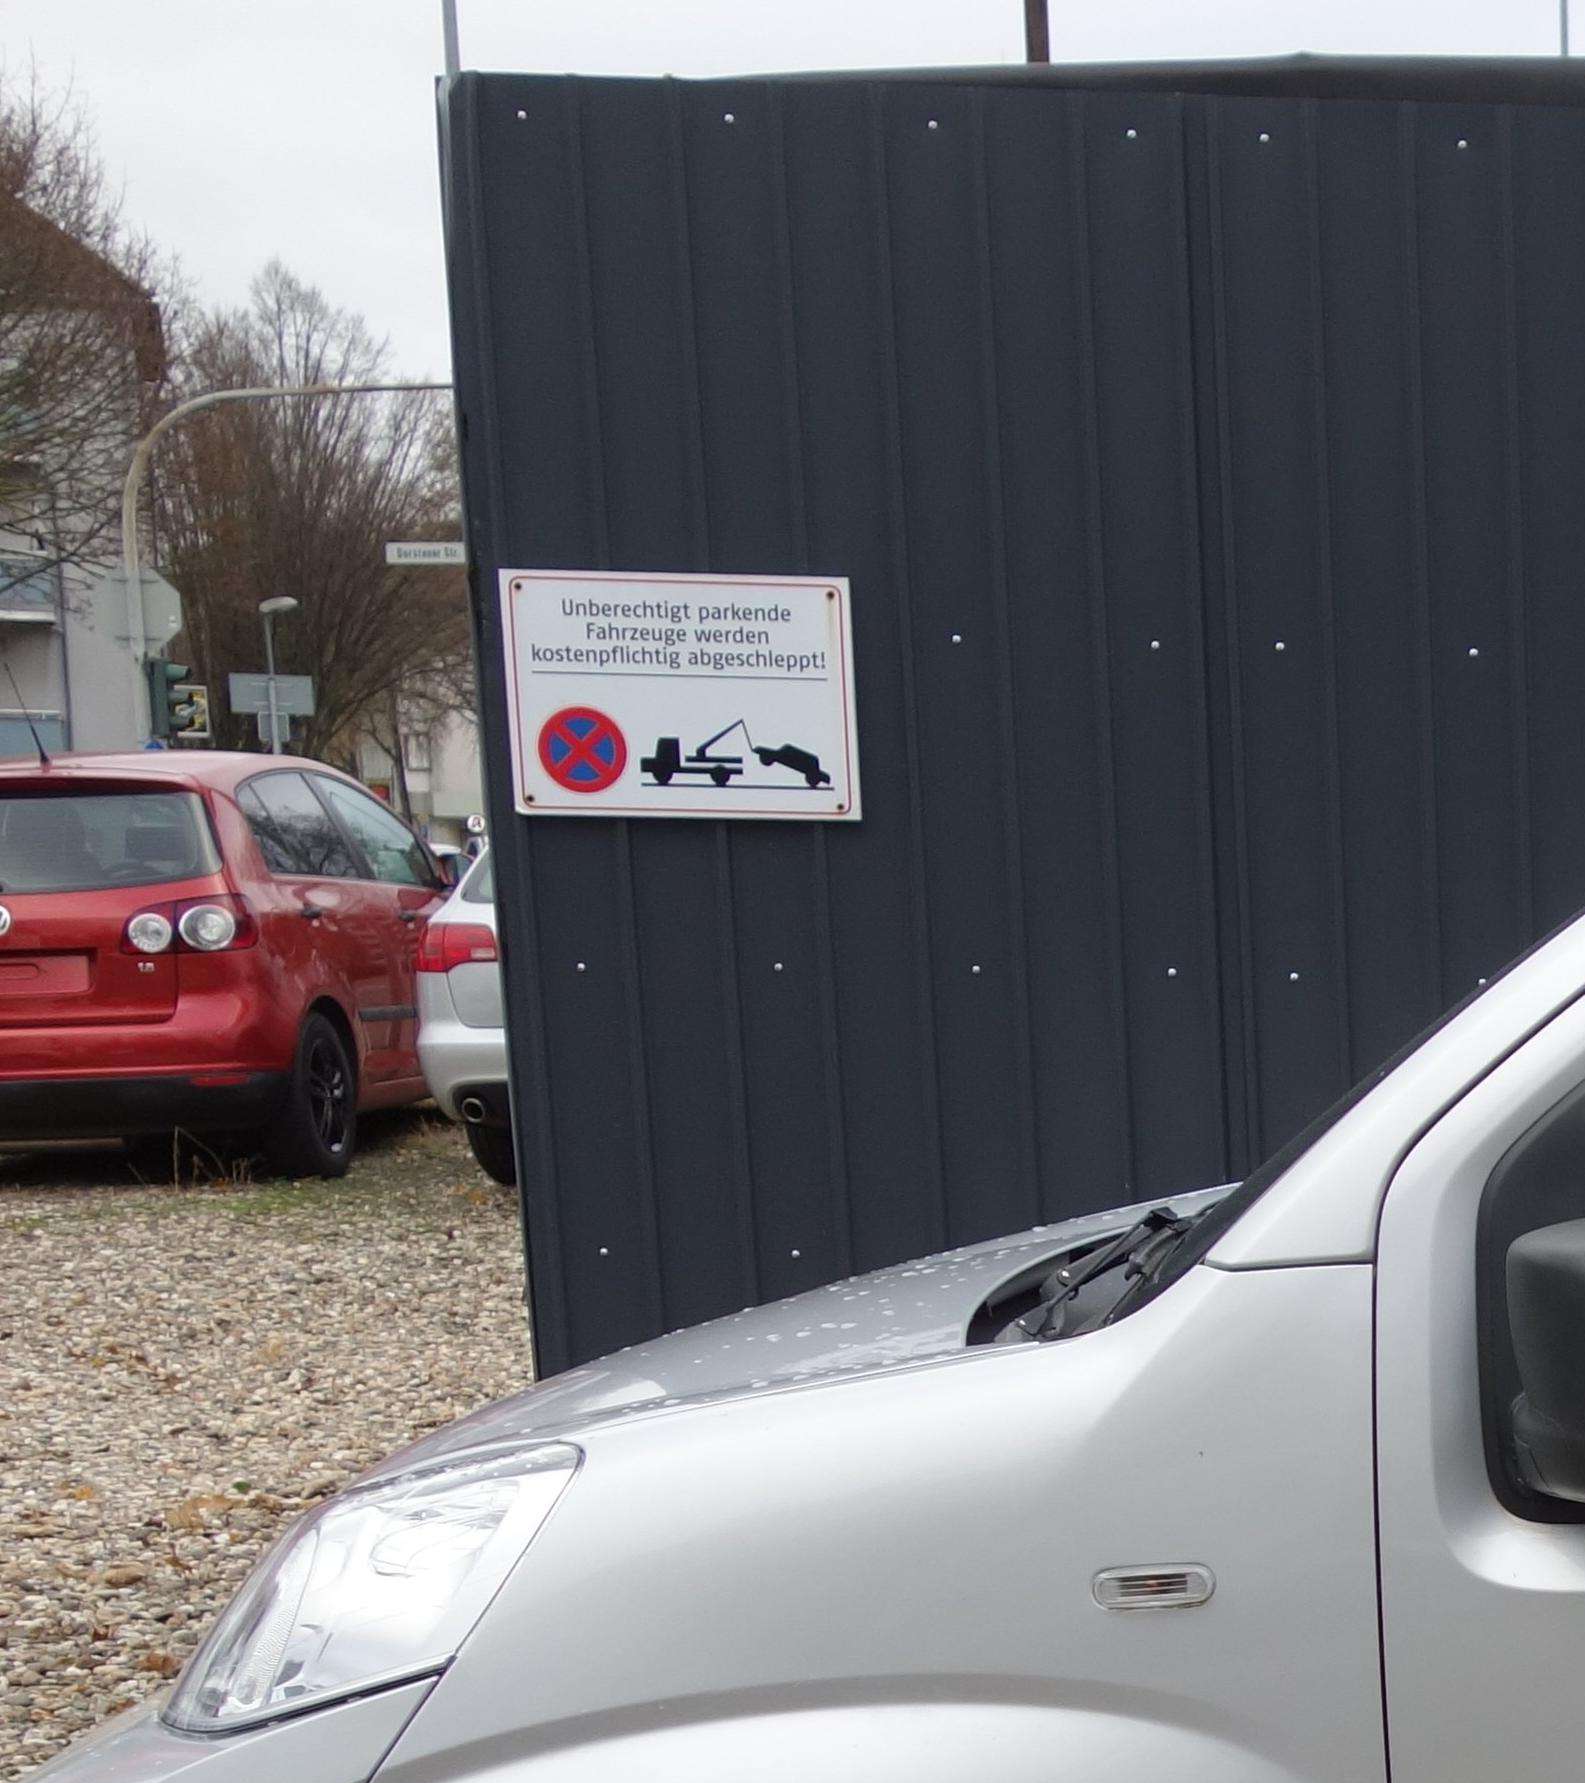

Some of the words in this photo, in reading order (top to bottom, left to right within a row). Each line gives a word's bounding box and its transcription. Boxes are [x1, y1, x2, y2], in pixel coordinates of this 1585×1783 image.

[561, 597, 691, 624] Unberechtigt
[698, 602, 792, 624] parkende
[586, 622, 687, 647] Fahrzeuge
[694, 626, 770, 645] werden
[531, 643, 681, 669] kostenpflichtig
[688, 648, 827, 673] abgeschleppt!
